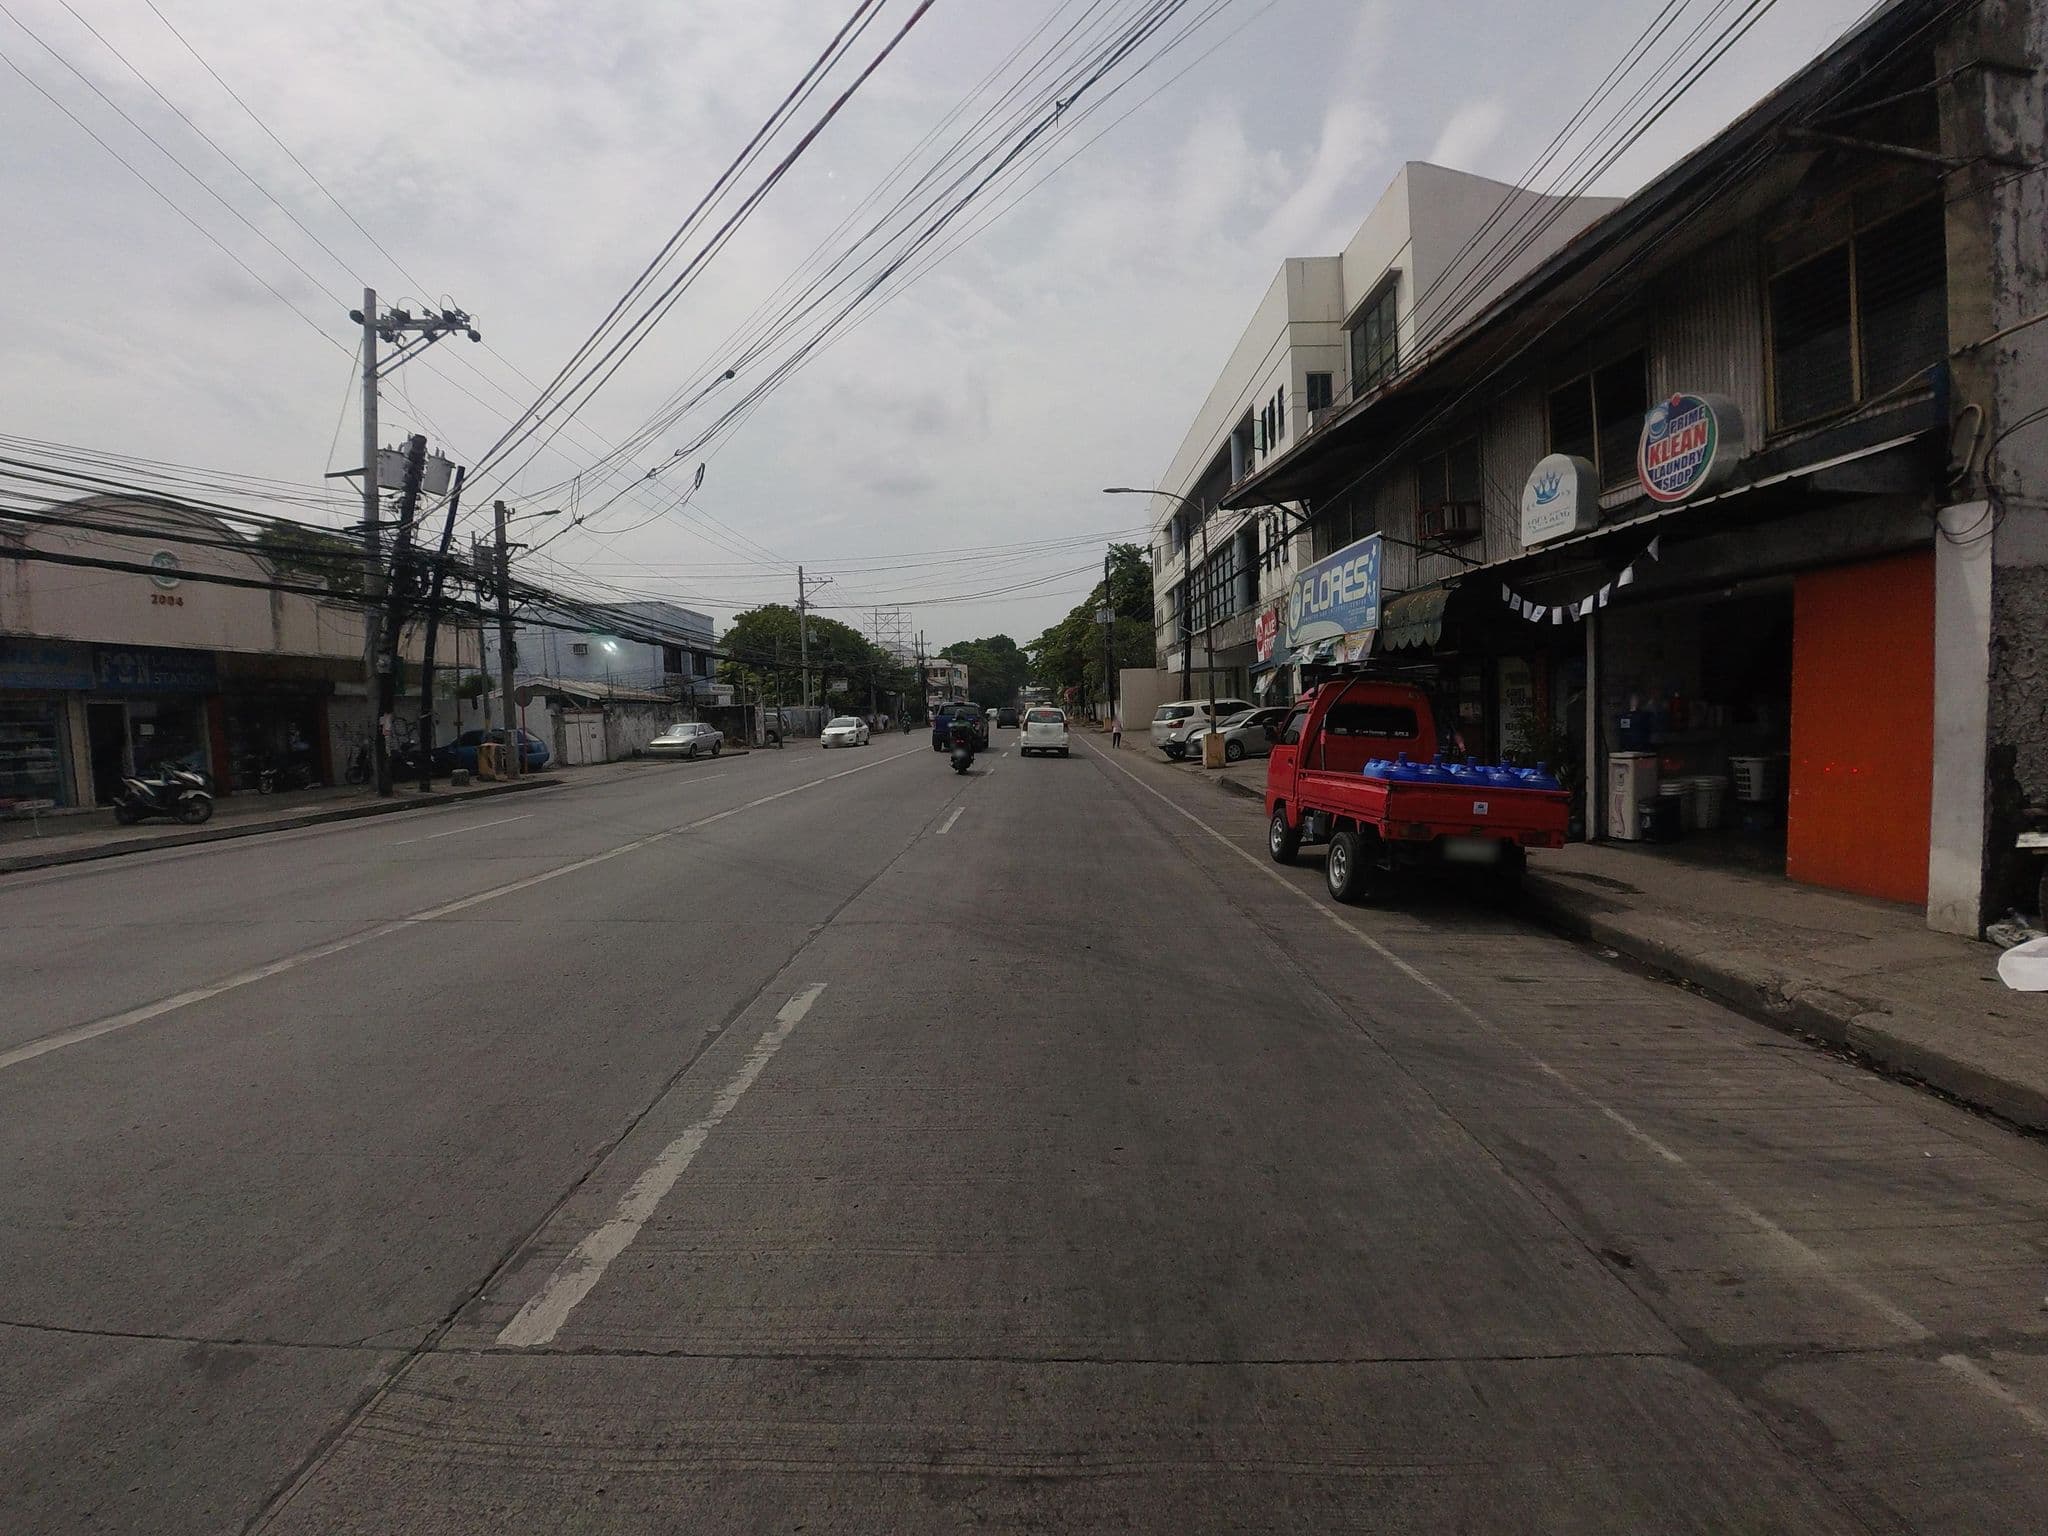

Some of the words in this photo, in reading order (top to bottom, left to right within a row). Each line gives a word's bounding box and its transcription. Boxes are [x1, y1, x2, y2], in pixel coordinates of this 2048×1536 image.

[1670, 405, 1705, 434] PRIME
[1649, 420, 1707, 468] KLEAN
[1654, 447, 1704, 482] LAUNDRY
[1662, 468, 1693, 490] SHOP
[1301, 554, 1370, 616] FLORES
